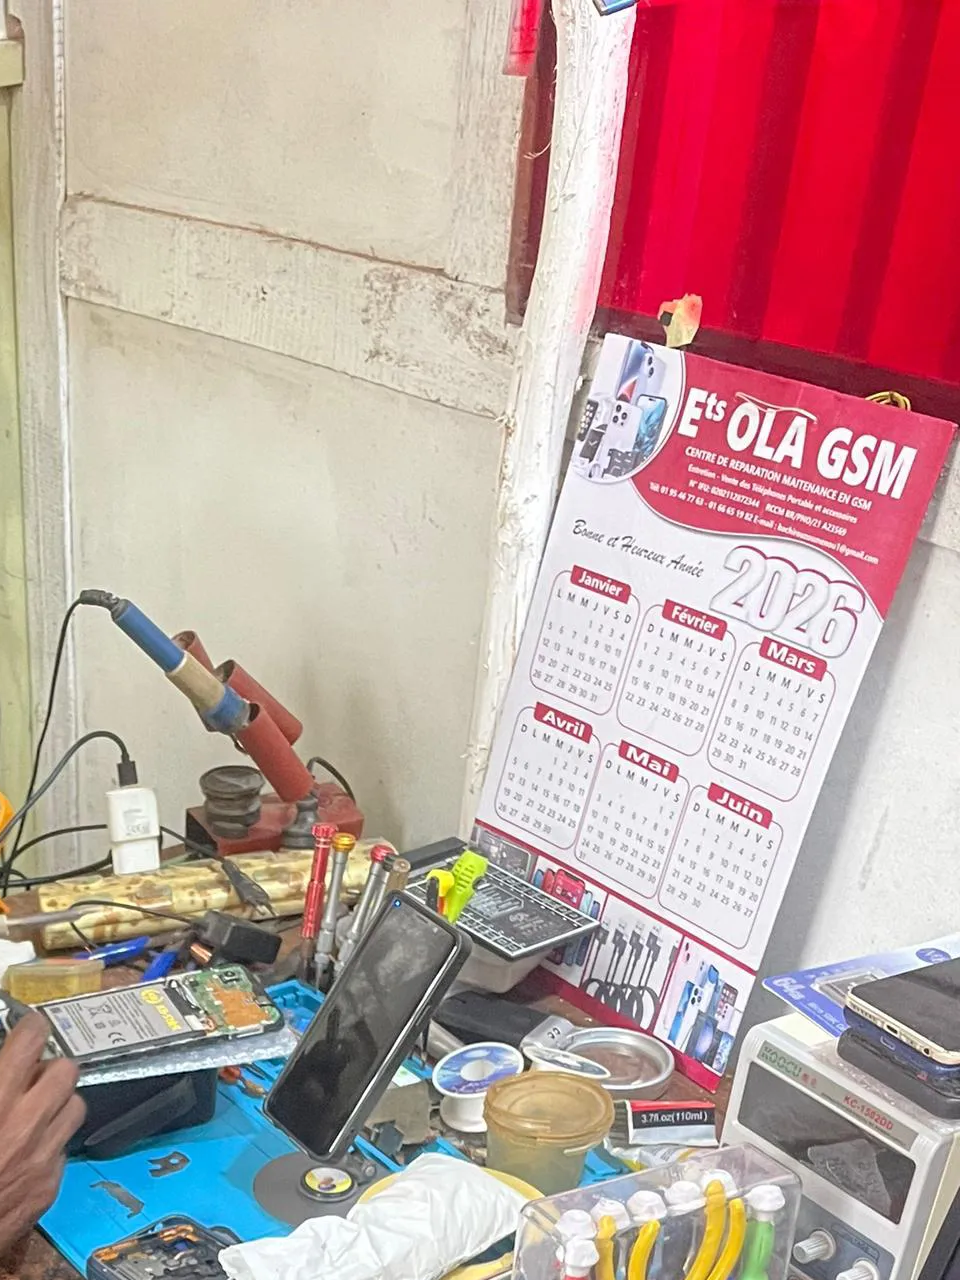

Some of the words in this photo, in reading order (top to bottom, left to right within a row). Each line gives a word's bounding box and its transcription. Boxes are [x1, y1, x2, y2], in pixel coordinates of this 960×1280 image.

[677, 387, 727, 438] Ets
[726, 402, 808, 469] OLA
[816, 427, 918, 500] GSM
[685, 446, 717, 463] CENTRE
[716, 455, 729, 467] DE
[728, 458, 782, 483] REPARATION
[781, 474, 838, 501] MAITENANCE
[837, 491, 851, 505] EN
[850, 496, 872, 511] GSM
[721, 473, 739, 486] Vente
[738, 479, 751, 490] des
[786, 494, 815, 510] Portable
[814, 504, 823, 512] et
[660, 485, 669, 495] 01
[668, 488, 678, 498] 95
[677, 491, 687, 501] 46
[686, 493, 696, 503] 77
[708, 500, 718, 510] 01
[726, 506, 735, 516] 65
[736, 509, 745, 519] 19
[743, 512, 754, 522] 82
[572, 519, 603, 543] Bonne
[607, 534, 620, 548] et
[619, 535, 666, 564] Heureux
[666, 554, 705, 578] Année
[578, 571, 623, 597] Janvier
[709, 545, 865, 658] 2026
[671, 605, 719, 634] Février
[766, 641, 817, 673] Mars
[542, 710, 586, 738] Avril
[626, 745, 672, 778] Mai
[715, 791, 764, 823] Juin
[760, 1046, 803, 1078] KOOCU
